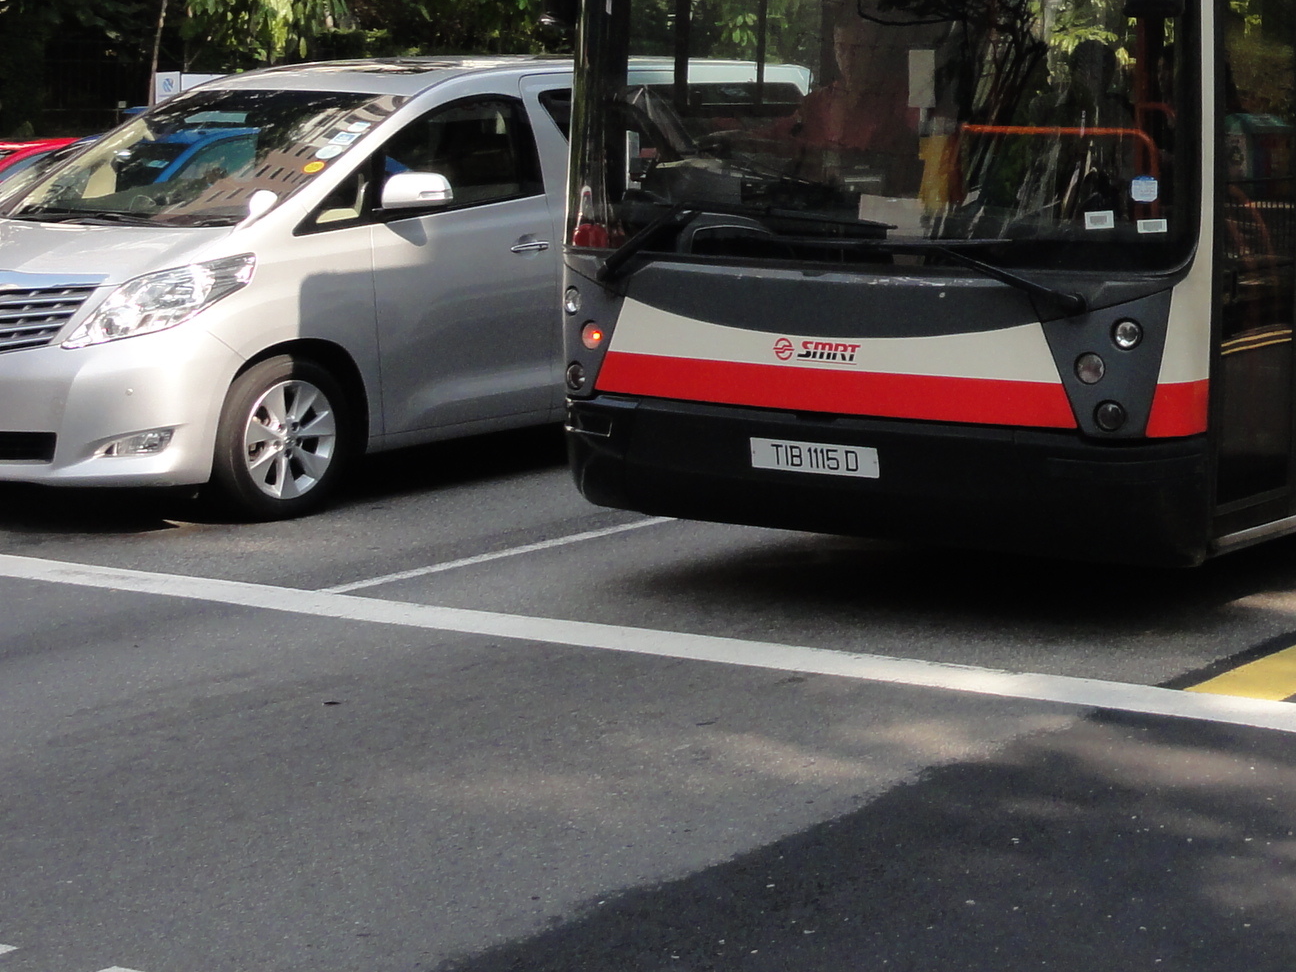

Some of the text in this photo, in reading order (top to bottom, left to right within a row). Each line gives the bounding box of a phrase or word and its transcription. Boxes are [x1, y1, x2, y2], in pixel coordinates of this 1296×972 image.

[797, 340, 861, 363] SMRT
[770, 443, 859, 472] TIB 1115 D
